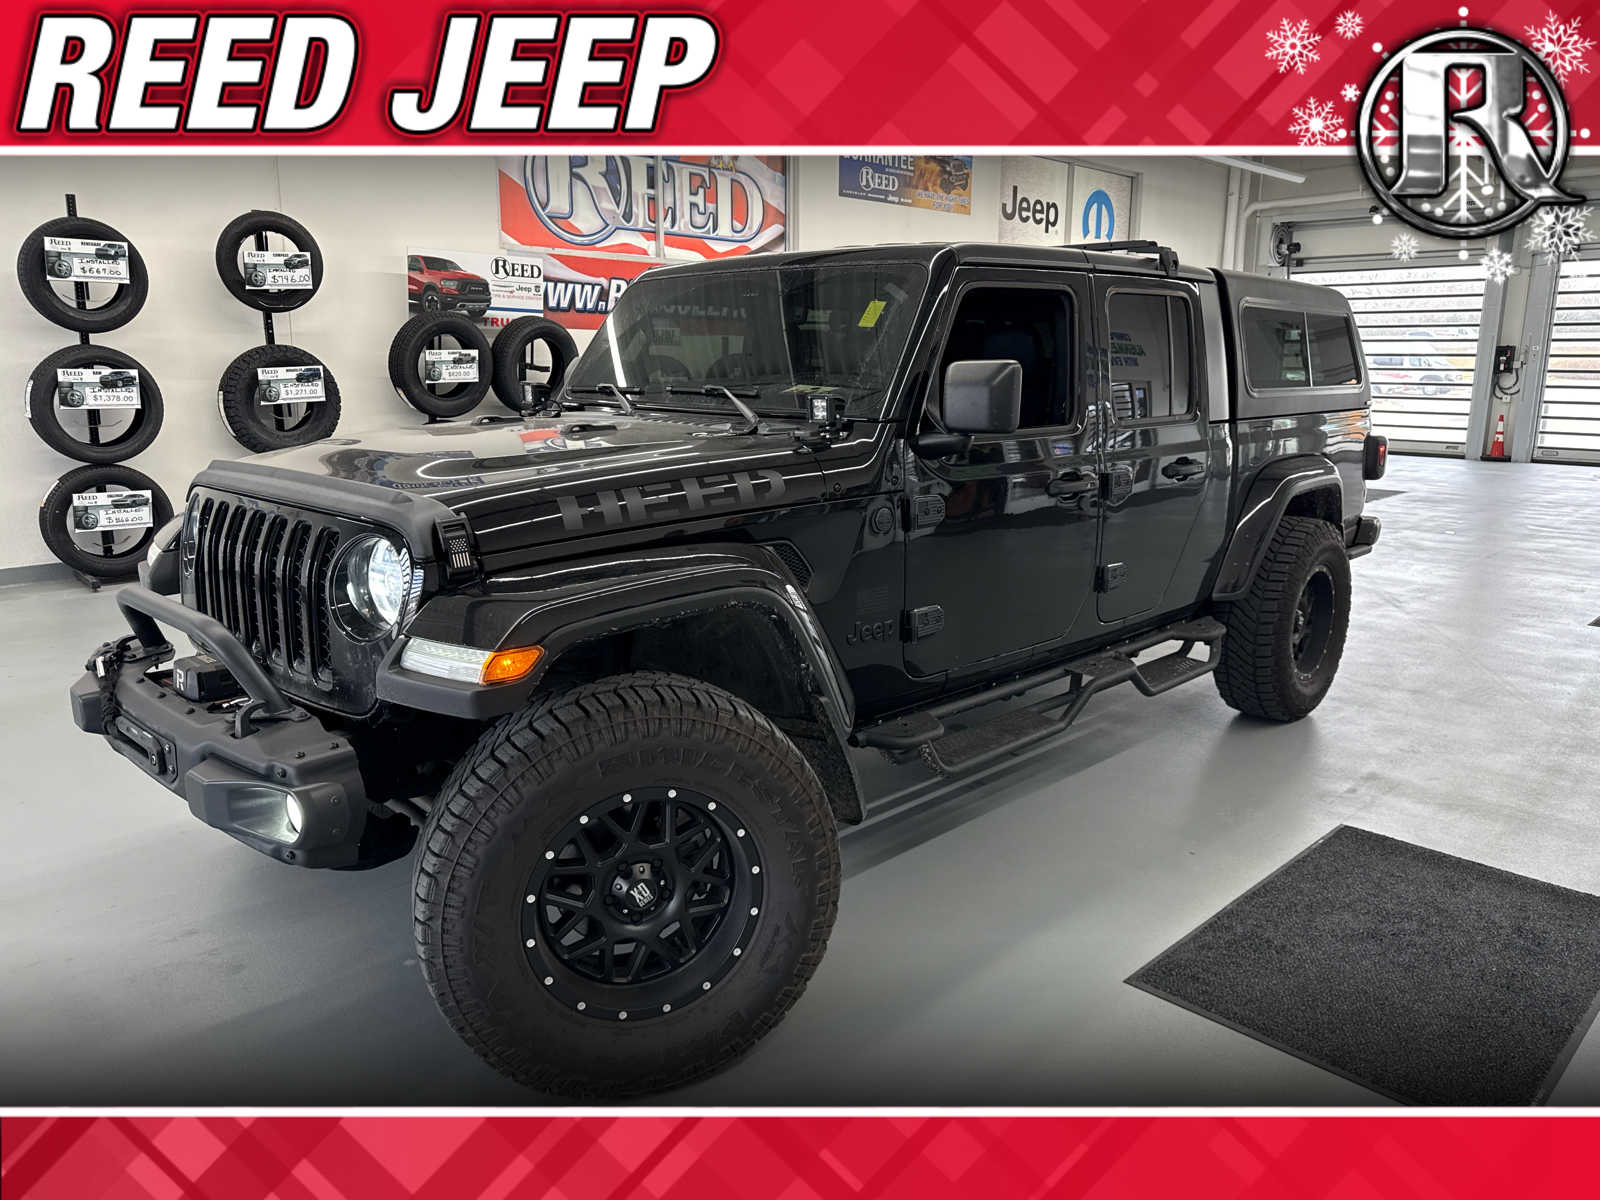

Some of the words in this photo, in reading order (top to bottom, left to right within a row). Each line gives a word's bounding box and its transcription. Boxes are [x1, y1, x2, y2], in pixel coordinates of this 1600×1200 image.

[859, 166, 898, 191] REED
[1001, 185, 1059, 233] Jeep
[490, 257, 542, 279] REED
[515, 284, 533, 296] Jeep
[847, 619, 894, 646] Jeep
